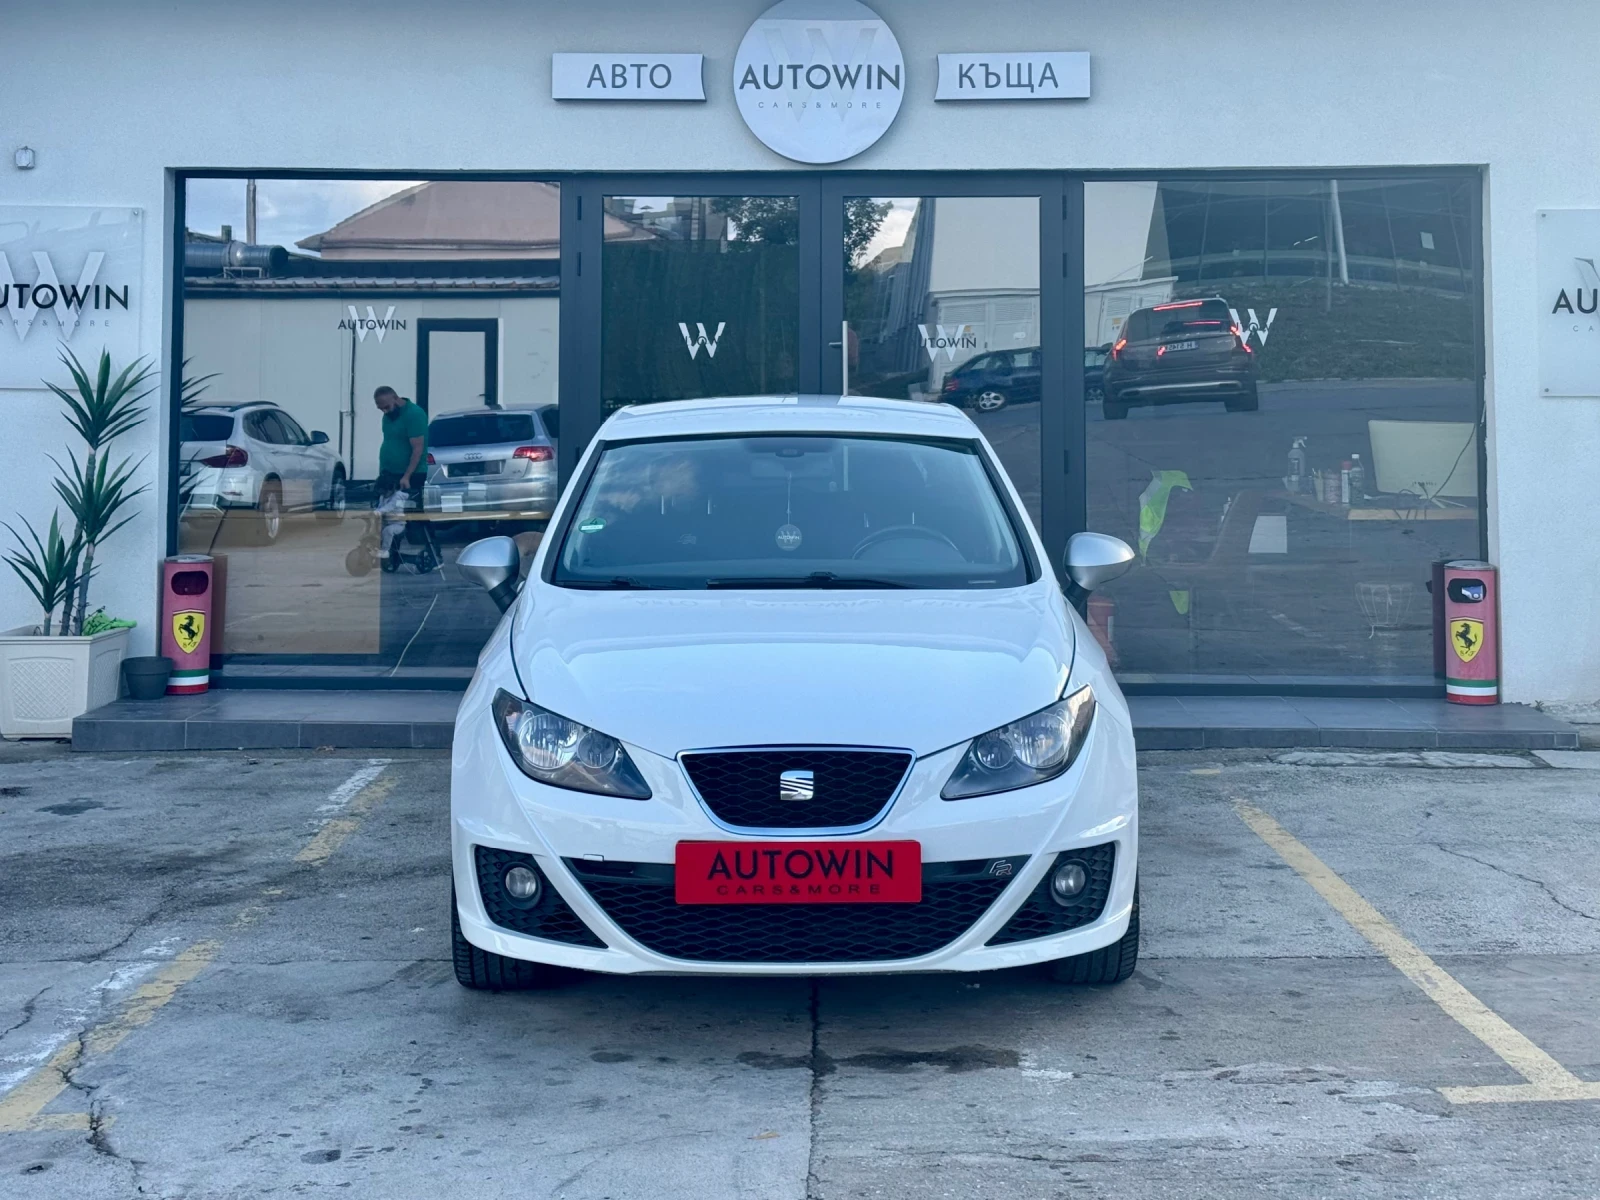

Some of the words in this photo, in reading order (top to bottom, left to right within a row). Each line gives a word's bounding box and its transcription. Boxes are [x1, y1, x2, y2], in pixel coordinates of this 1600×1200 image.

[587, 63, 672, 89] АВТО
[739, 64, 900, 90] AUTOWIN
[959, 62, 1059, 93] КЪЩА
[1552, 288, 1598, 314] AU
[338, 319, 407, 331] AUTOWIN
[678, 322, 726, 360] W
[707, 849, 894, 880] AUTOWIN
[716, 884, 880, 896] CARS&MORE
